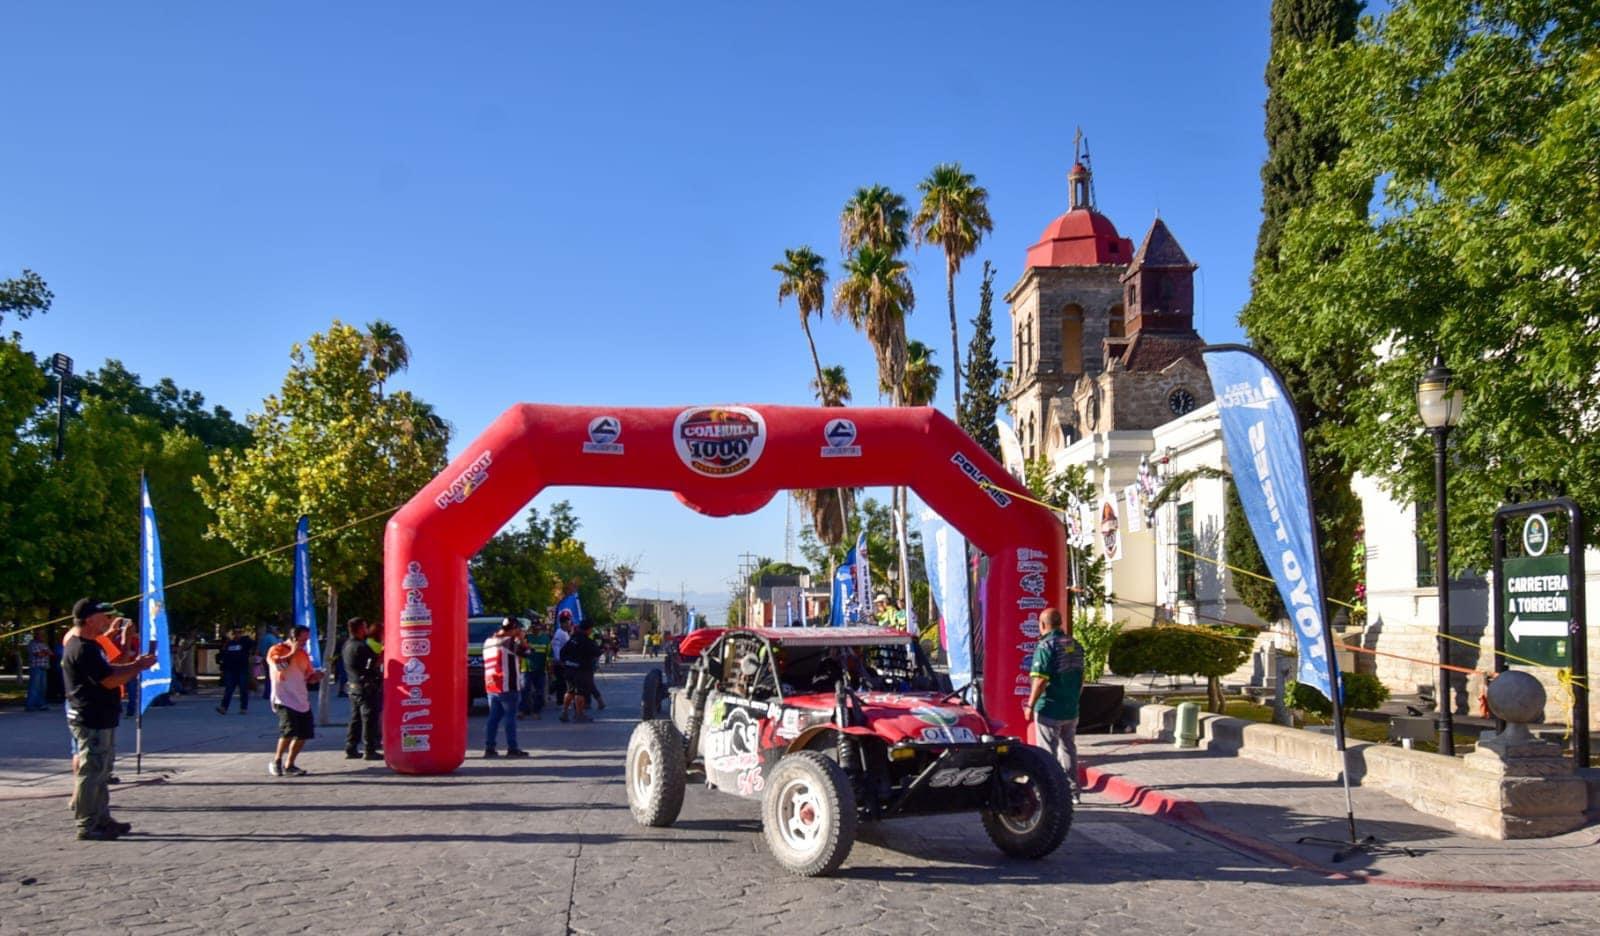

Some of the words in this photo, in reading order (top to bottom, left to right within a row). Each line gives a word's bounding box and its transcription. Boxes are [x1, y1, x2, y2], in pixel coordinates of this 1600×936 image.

[684, 424, 755, 437] COAHUILA
[690, 439, 749, 459] 1000
[952, 453, 1010, 507] POLARIS
[1508, 575, 1568, 593] CARRETERA
[1509, 598, 1517, 613] A
[1517, 592, 1567, 613] TORREÓN
